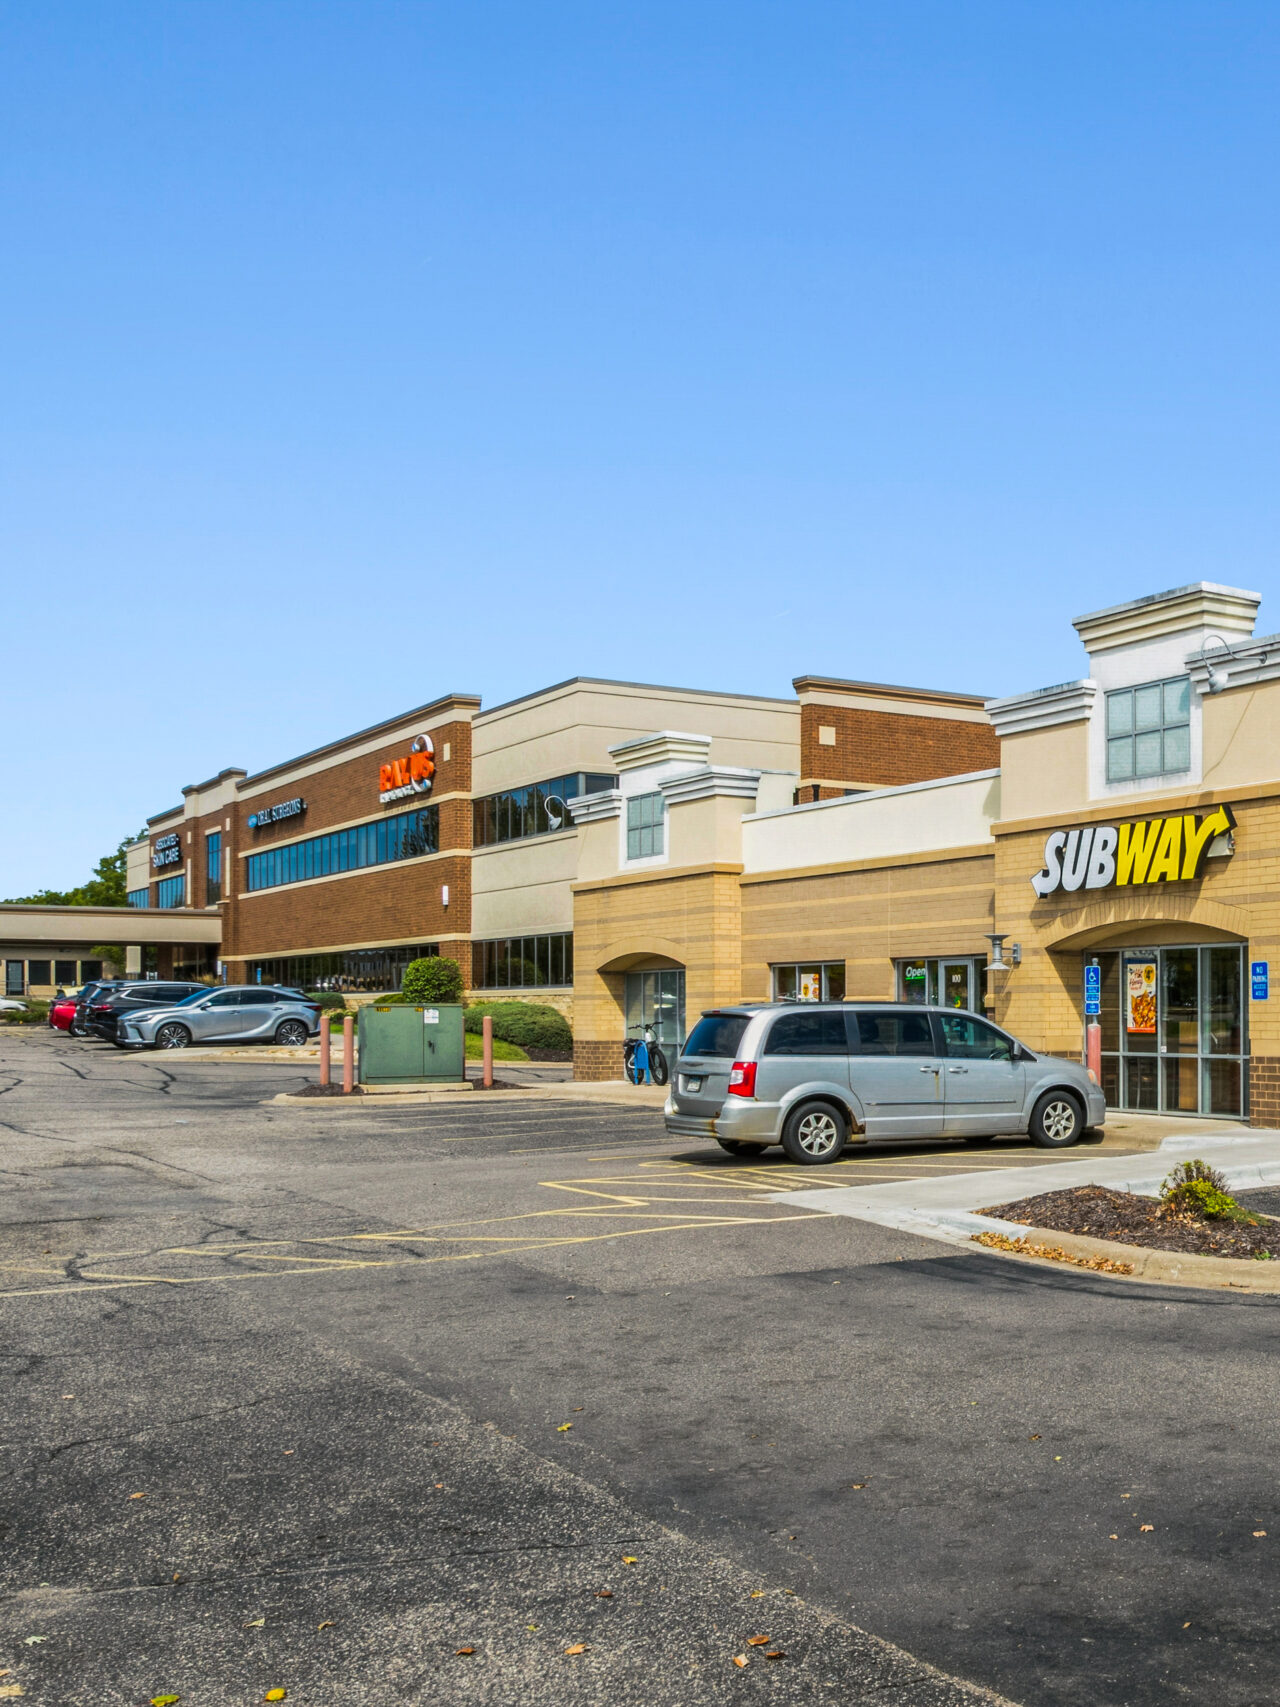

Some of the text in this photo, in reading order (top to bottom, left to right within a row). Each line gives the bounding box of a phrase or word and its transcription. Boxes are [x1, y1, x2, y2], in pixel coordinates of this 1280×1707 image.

[1030, 804, 1237, 899] SUBWAY
[905, 966, 926, 980] Open
[1255, 966, 1264, 974] NO
[952, 974, 962, 983] 100
